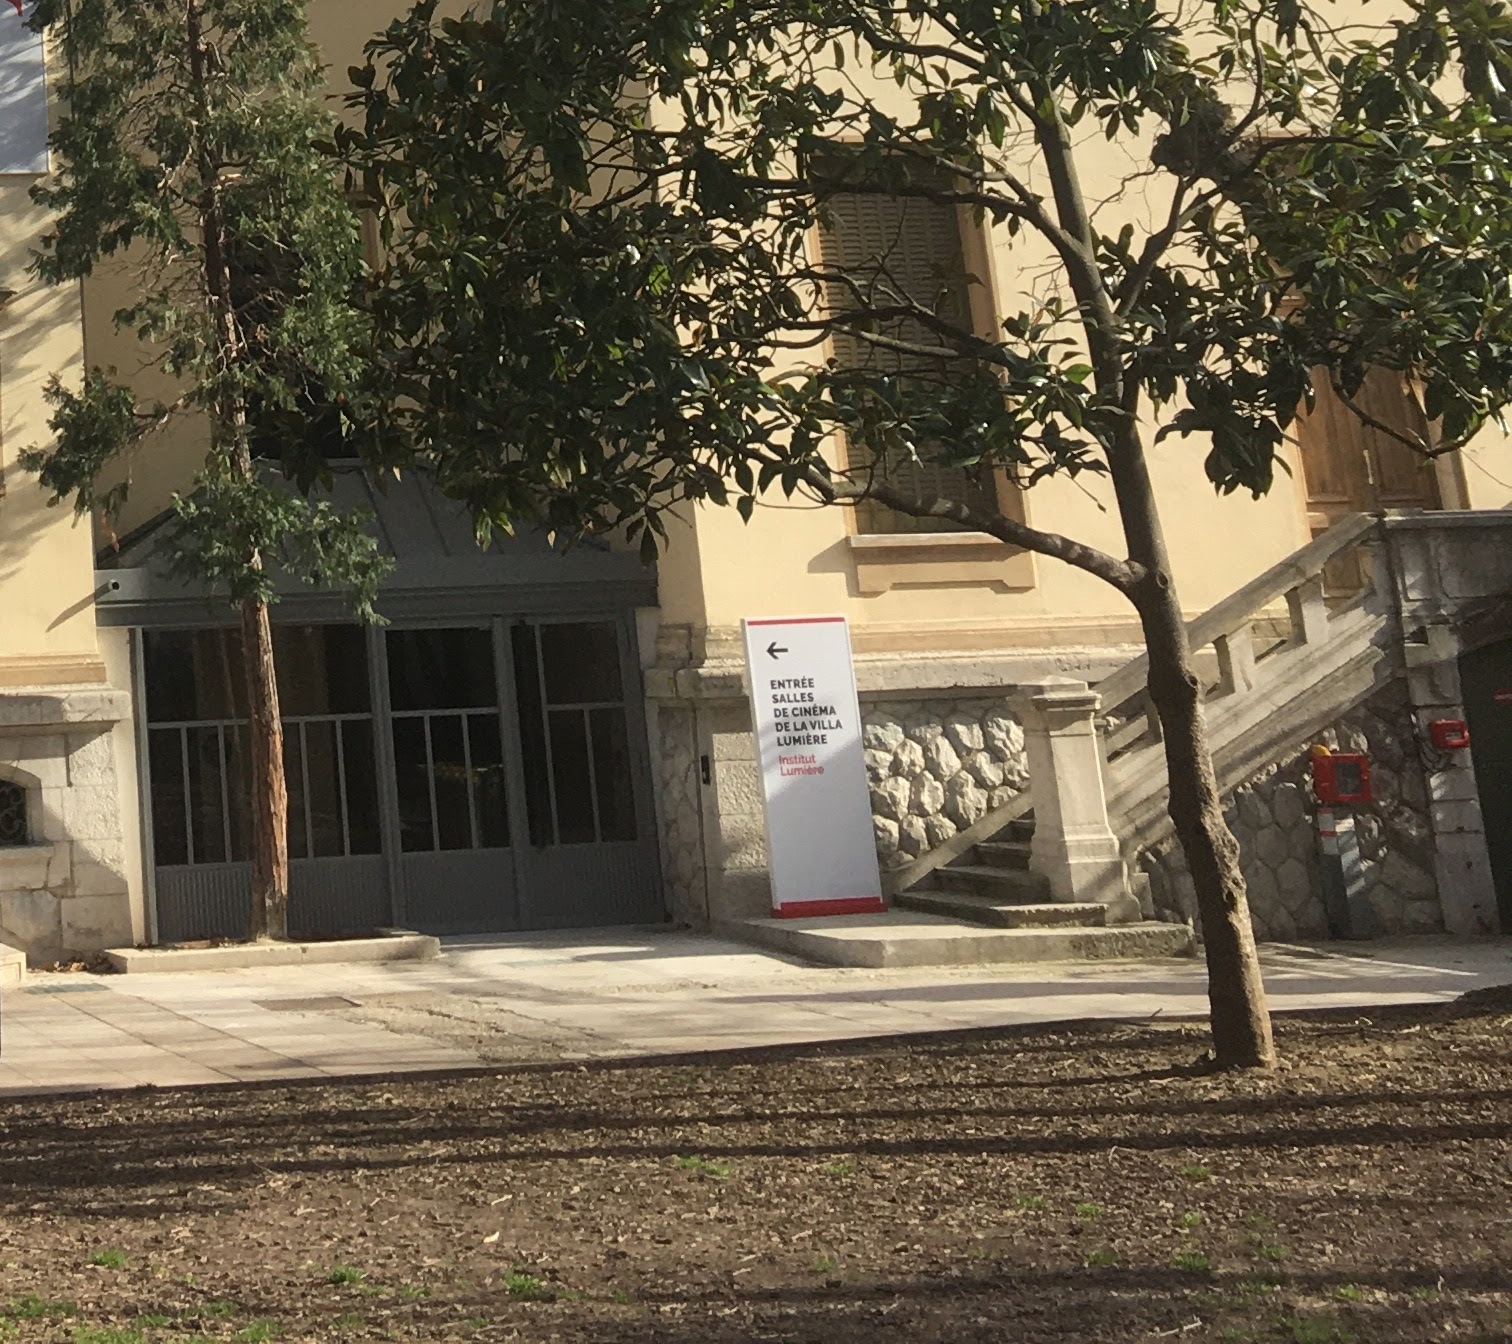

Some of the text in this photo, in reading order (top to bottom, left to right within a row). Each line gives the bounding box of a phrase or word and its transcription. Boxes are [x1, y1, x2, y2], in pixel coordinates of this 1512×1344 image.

[770, 676, 815, 690] ENTRÉE
[771, 692, 814, 704] SALLES
[774, 703, 836, 718] DE CINÉMA
[775, 718, 842, 732] DE LA VILLA
[777, 732, 827, 747] LUMIÈRE
[778, 754, 816, 765] Institut
[780, 765, 825, 777] Lumière
